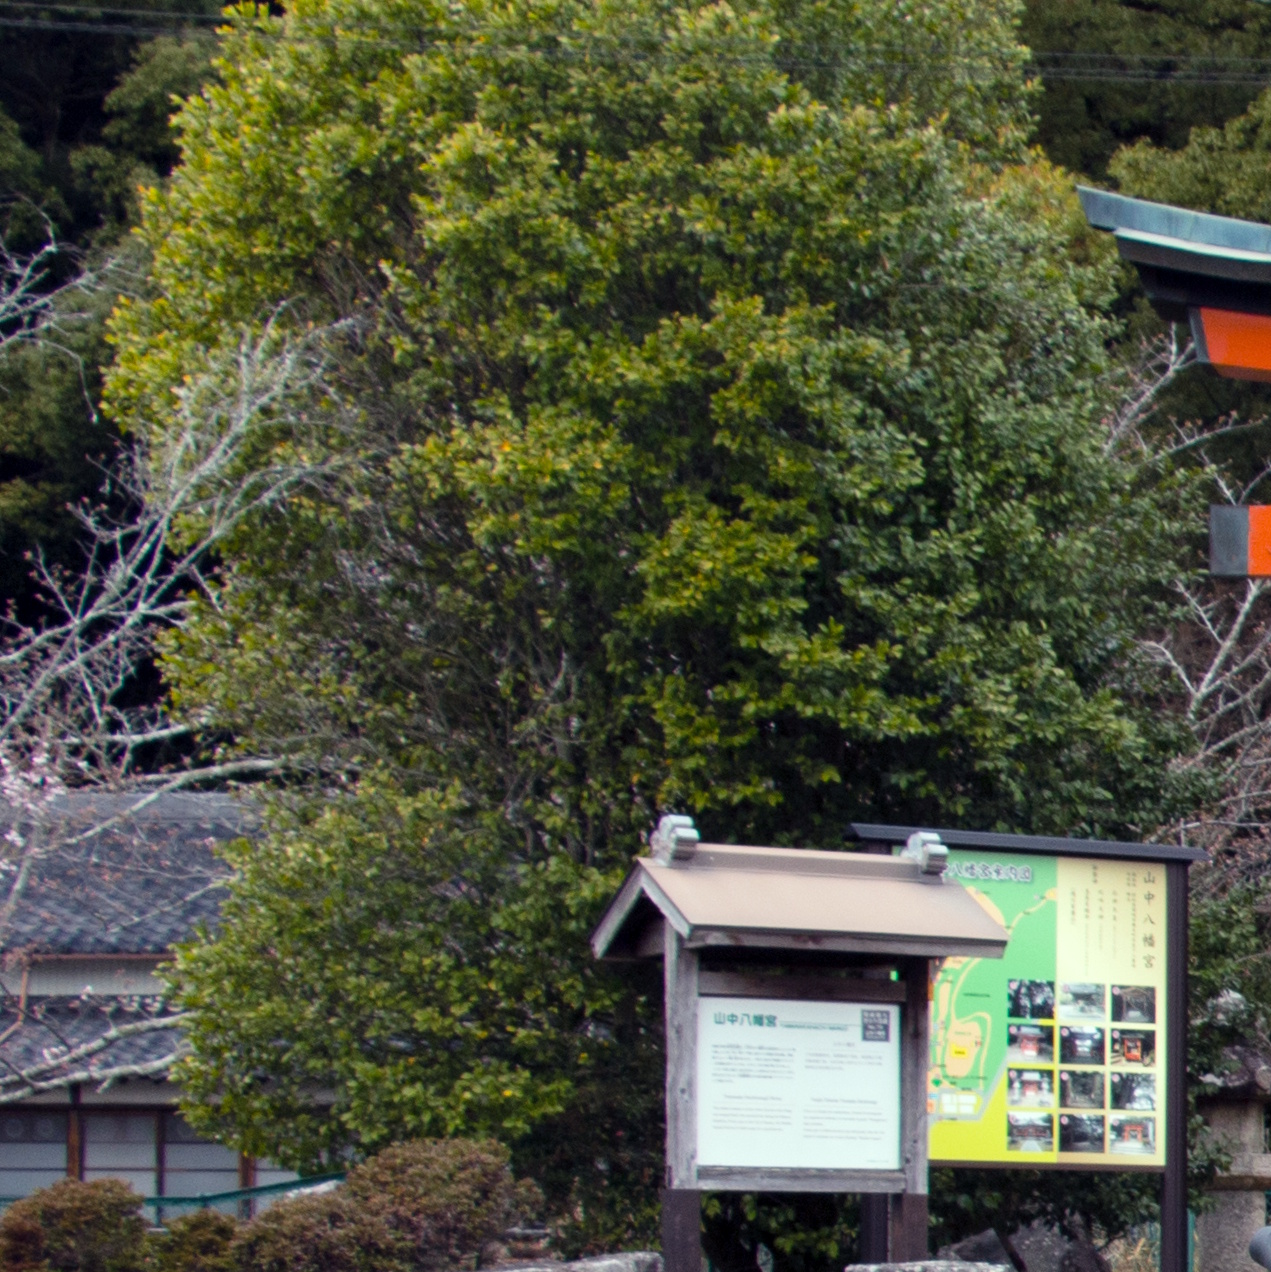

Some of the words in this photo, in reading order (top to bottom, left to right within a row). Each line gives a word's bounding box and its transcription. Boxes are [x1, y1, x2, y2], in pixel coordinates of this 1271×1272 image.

[1142, 870, 1156, 969] 山中八幡宮
[713, 1011, 778, 1028] 山中八幡宮
